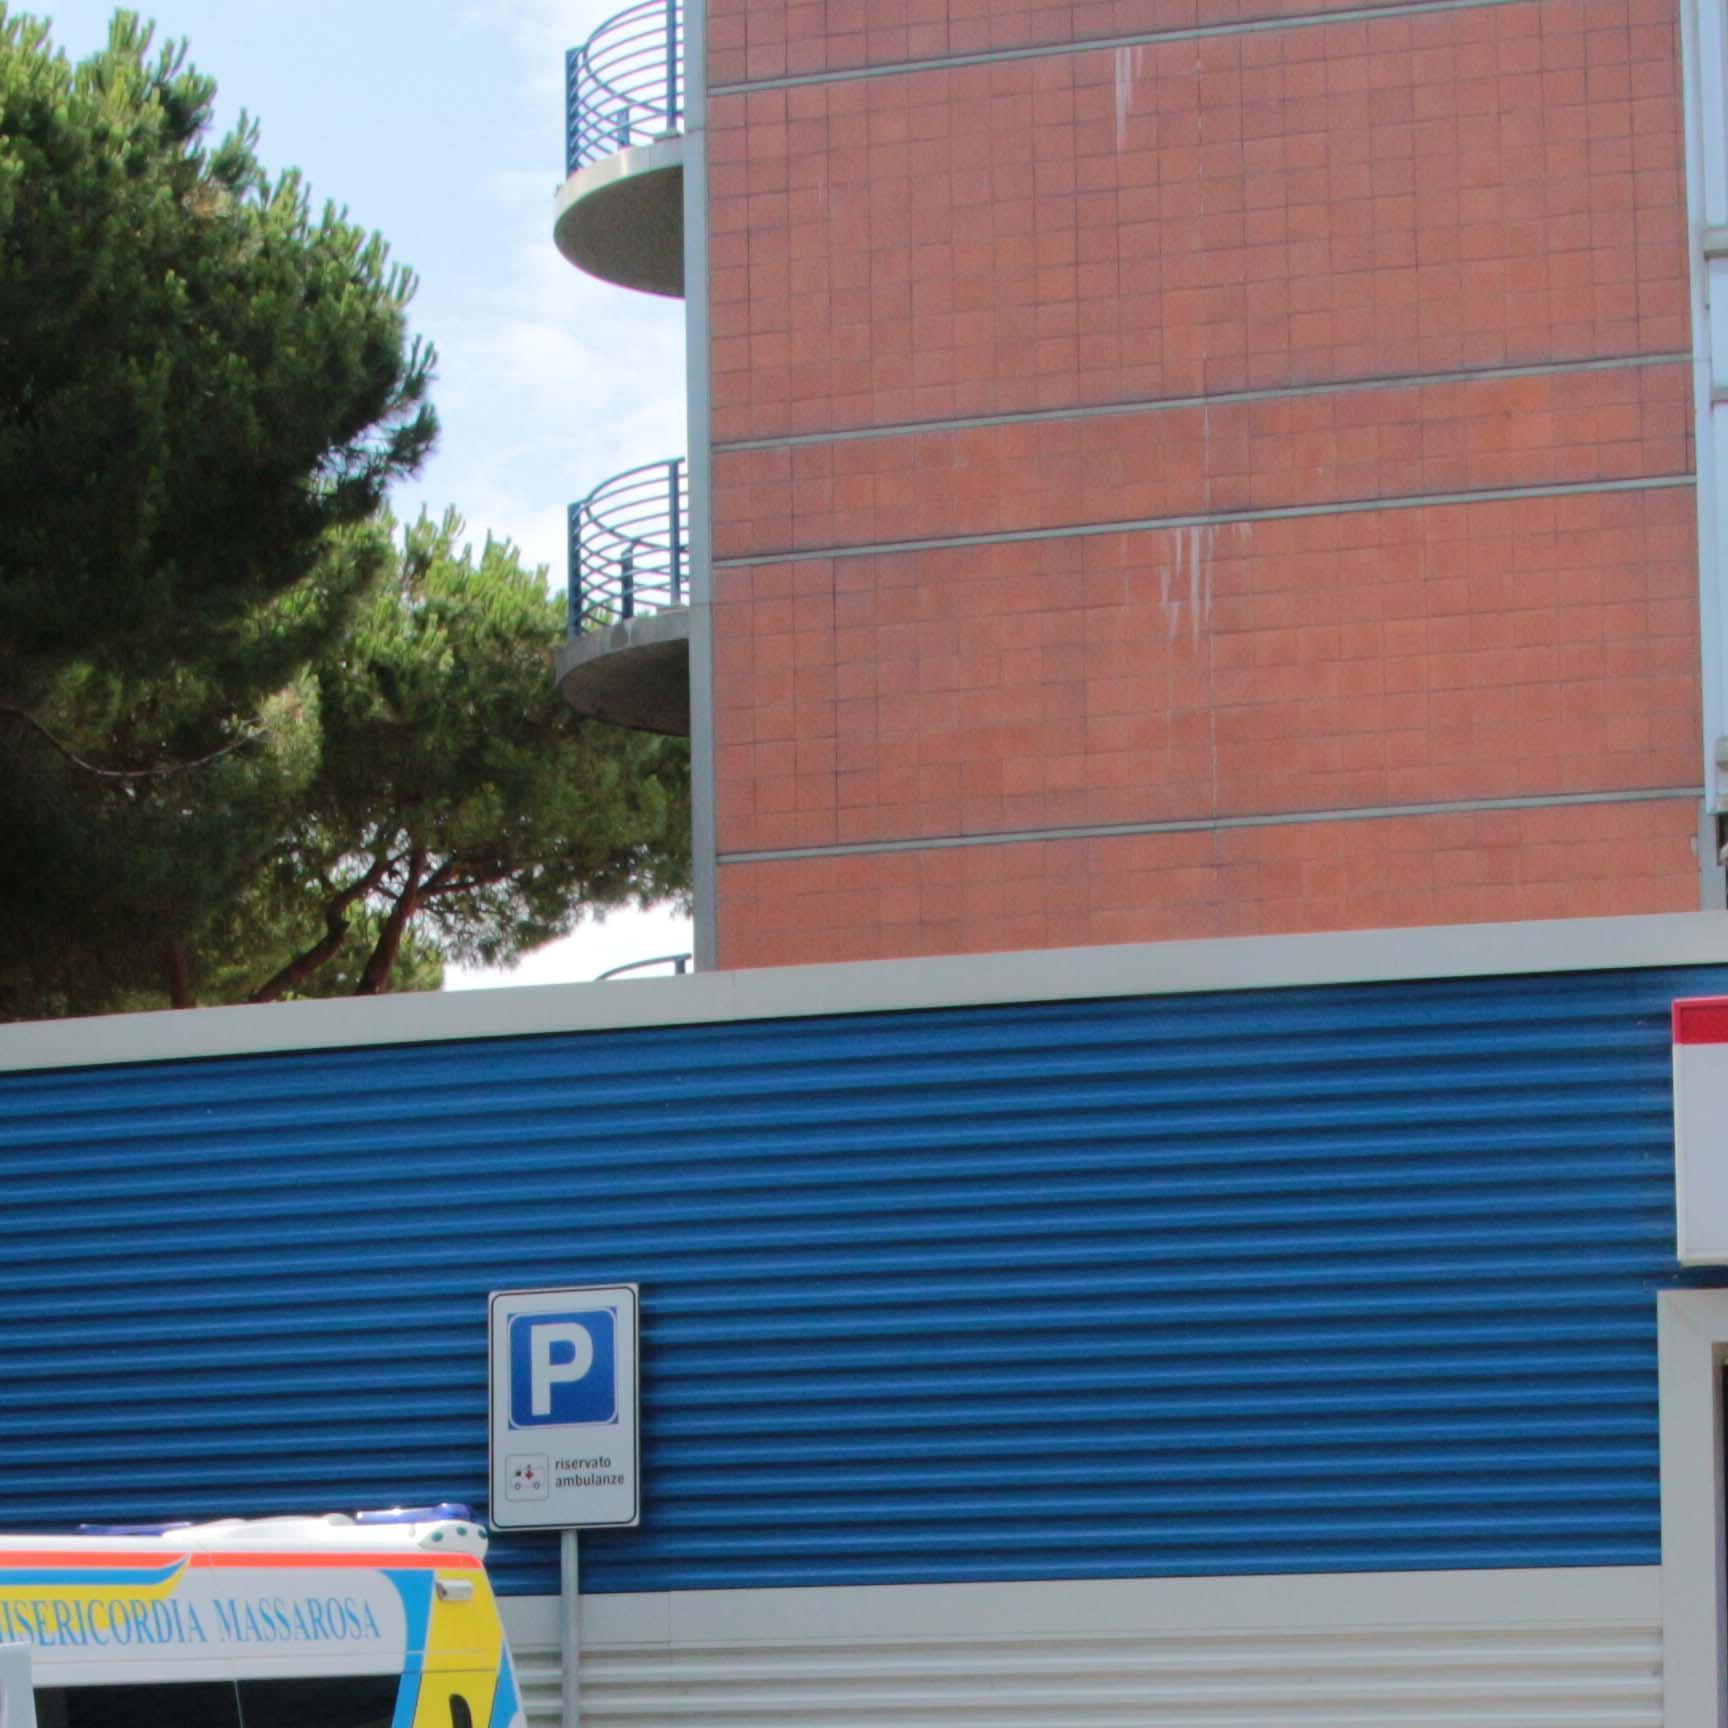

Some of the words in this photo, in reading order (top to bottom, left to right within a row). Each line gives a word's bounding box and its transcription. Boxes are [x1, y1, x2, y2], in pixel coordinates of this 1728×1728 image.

[530, 1322, 593, 1416] P
[555, 1456, 611, 1471] riservato
[555, 1472, 624, 1488] ambulanze
[214, 1597, 382, 1644] MASSAROSA
